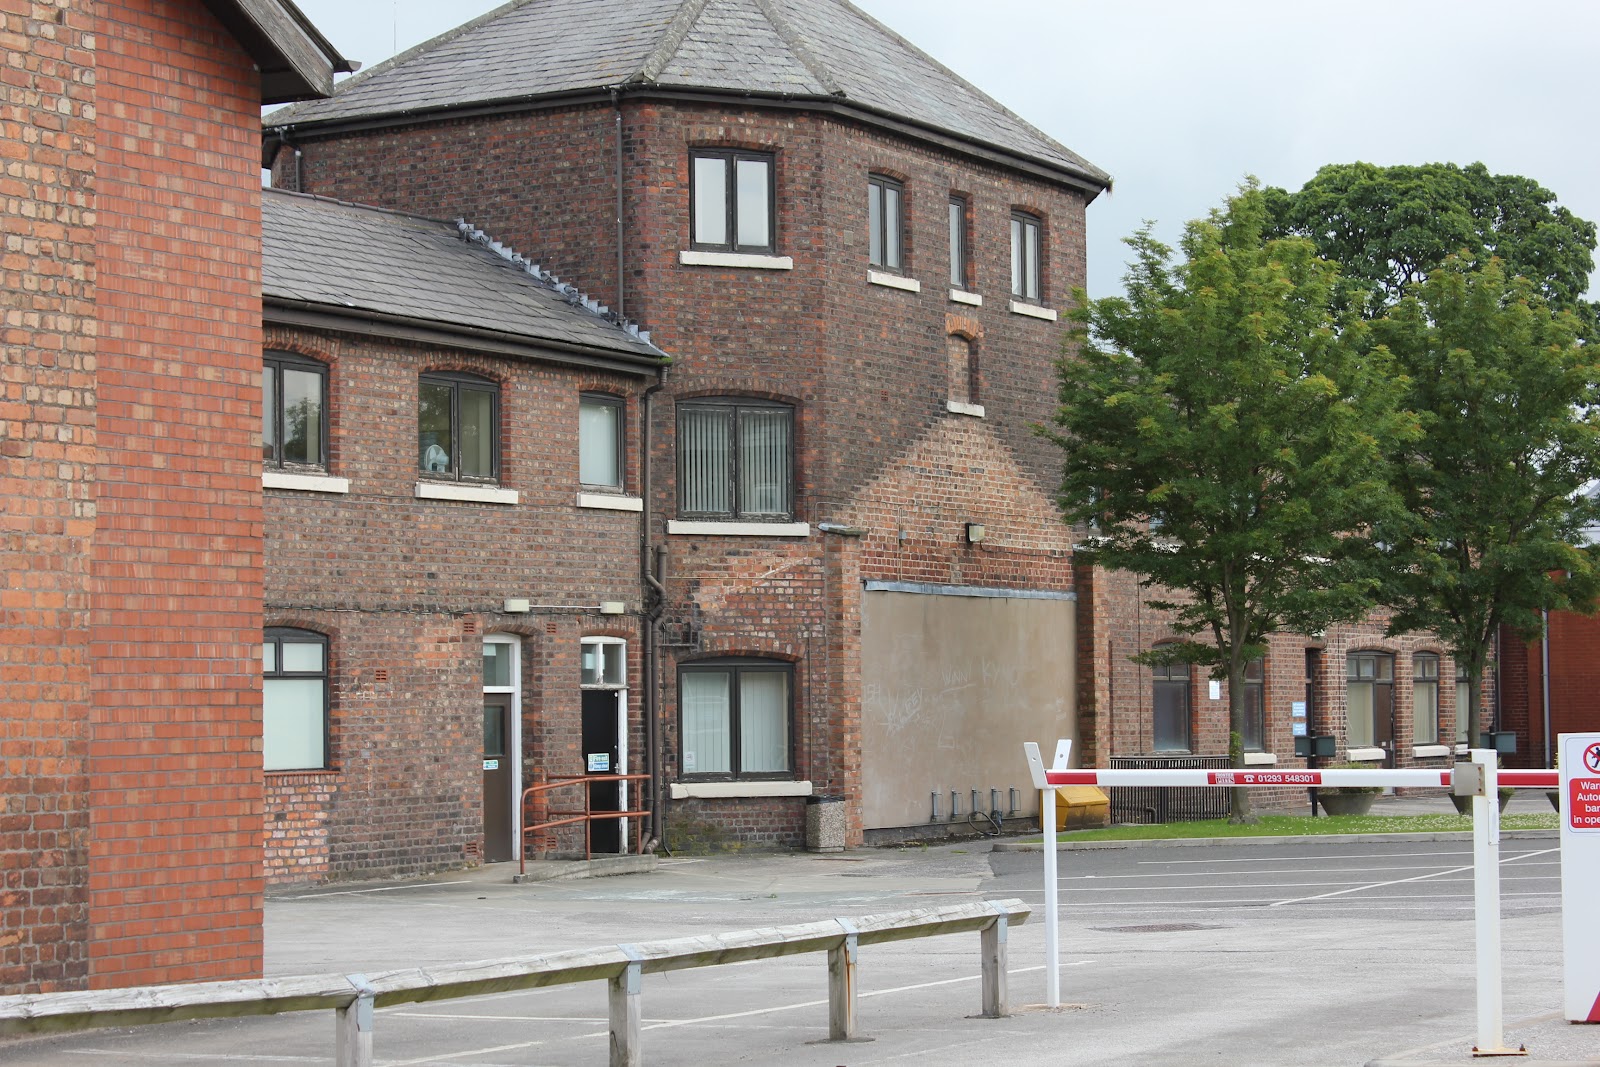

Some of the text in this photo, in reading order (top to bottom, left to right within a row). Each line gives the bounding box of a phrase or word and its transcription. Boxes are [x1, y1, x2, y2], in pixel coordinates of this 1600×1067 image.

[1258, 774, 1314, 783] 01293 548301
[1577, 792, 1600, 801] Auto
[1573, 814, 1582, 824] in
